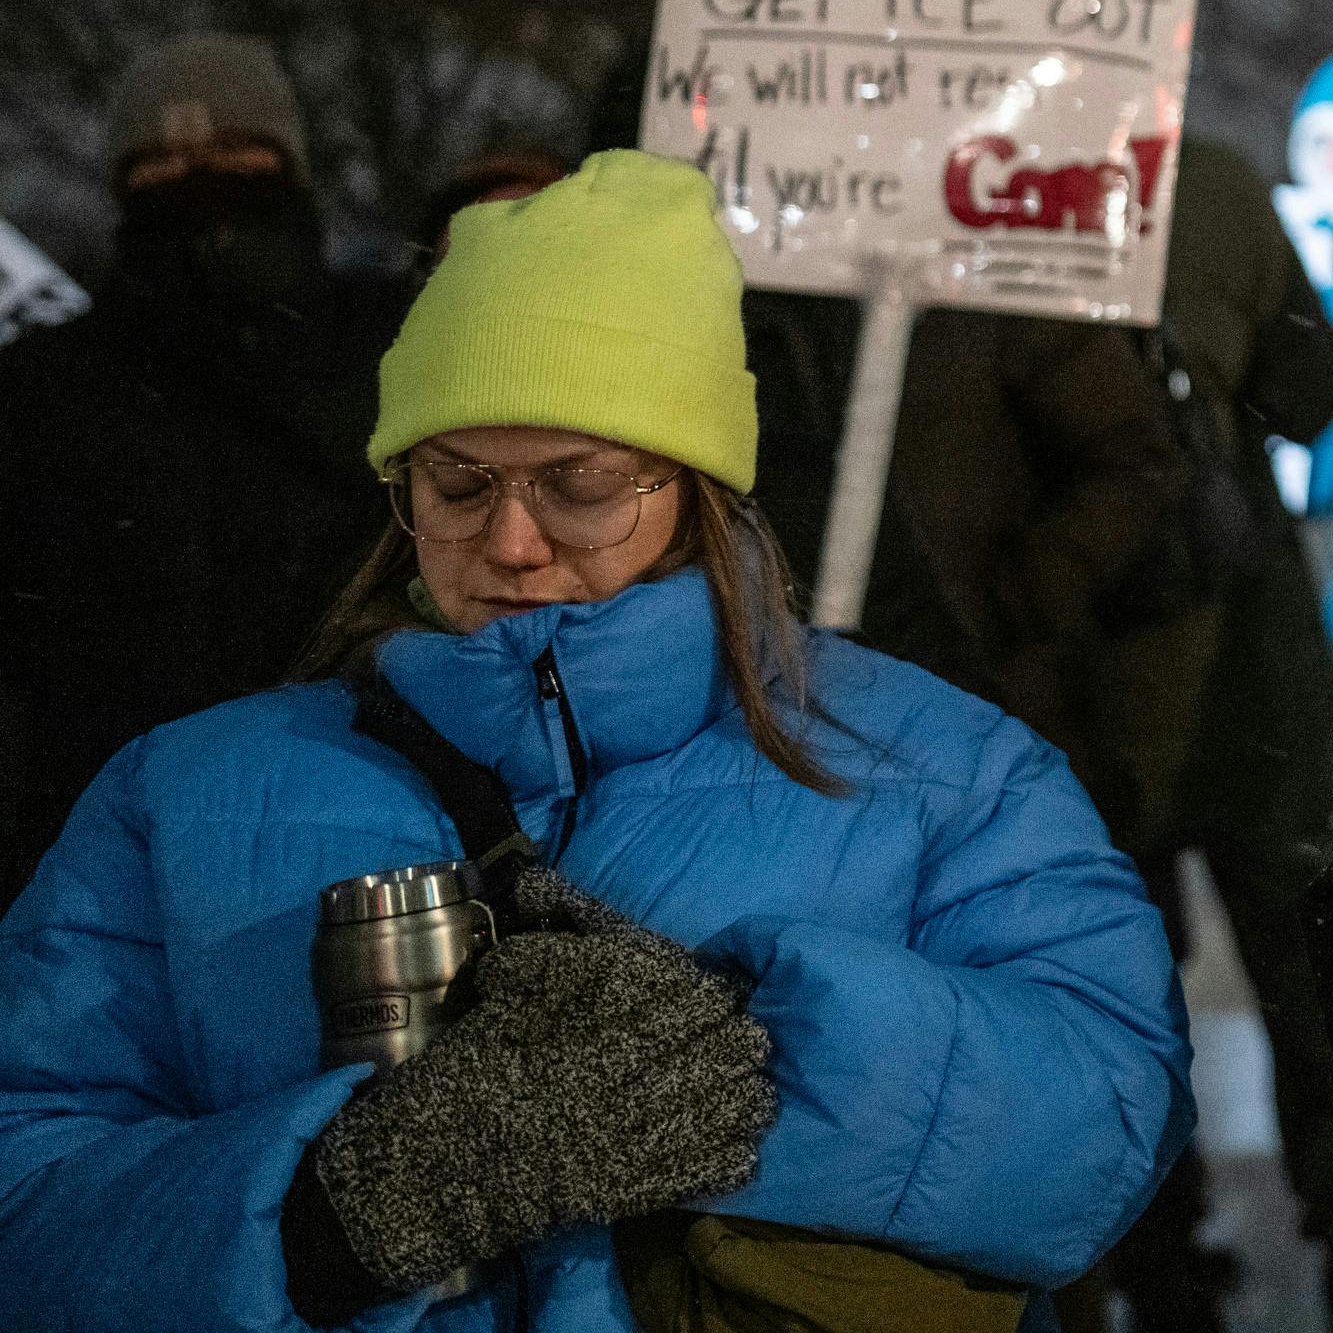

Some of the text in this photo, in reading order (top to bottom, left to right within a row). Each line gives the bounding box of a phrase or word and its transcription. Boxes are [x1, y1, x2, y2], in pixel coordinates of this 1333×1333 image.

[655, 43, 732, 107] We
[745, 47, 828, 107] will
[843, 47, 912, 105] not
[765, 153, 902, 253] you're
